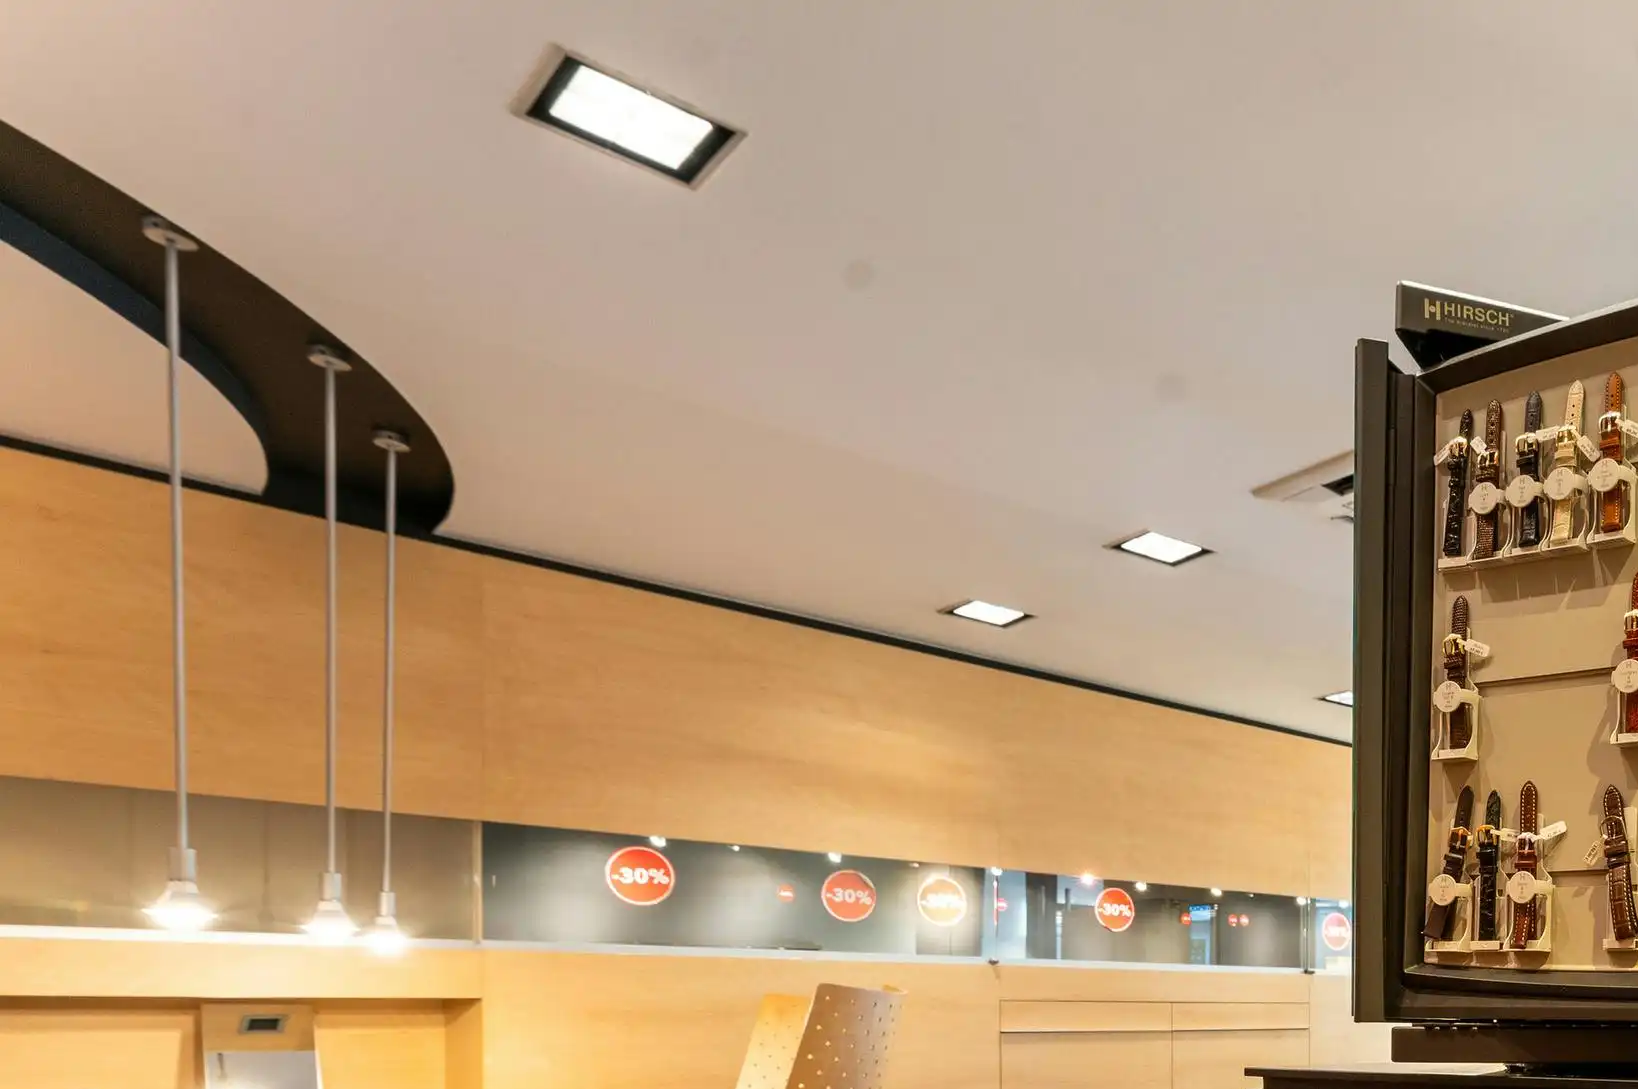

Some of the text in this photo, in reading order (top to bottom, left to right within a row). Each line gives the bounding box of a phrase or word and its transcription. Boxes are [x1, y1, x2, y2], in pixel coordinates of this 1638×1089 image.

[1444, 301, 1510, 327] HIRSCH
[611, 867, 670, 885] -30%
[826, 887, 873, 905] -30%
[1098, 903, 1131, 918] -30%
